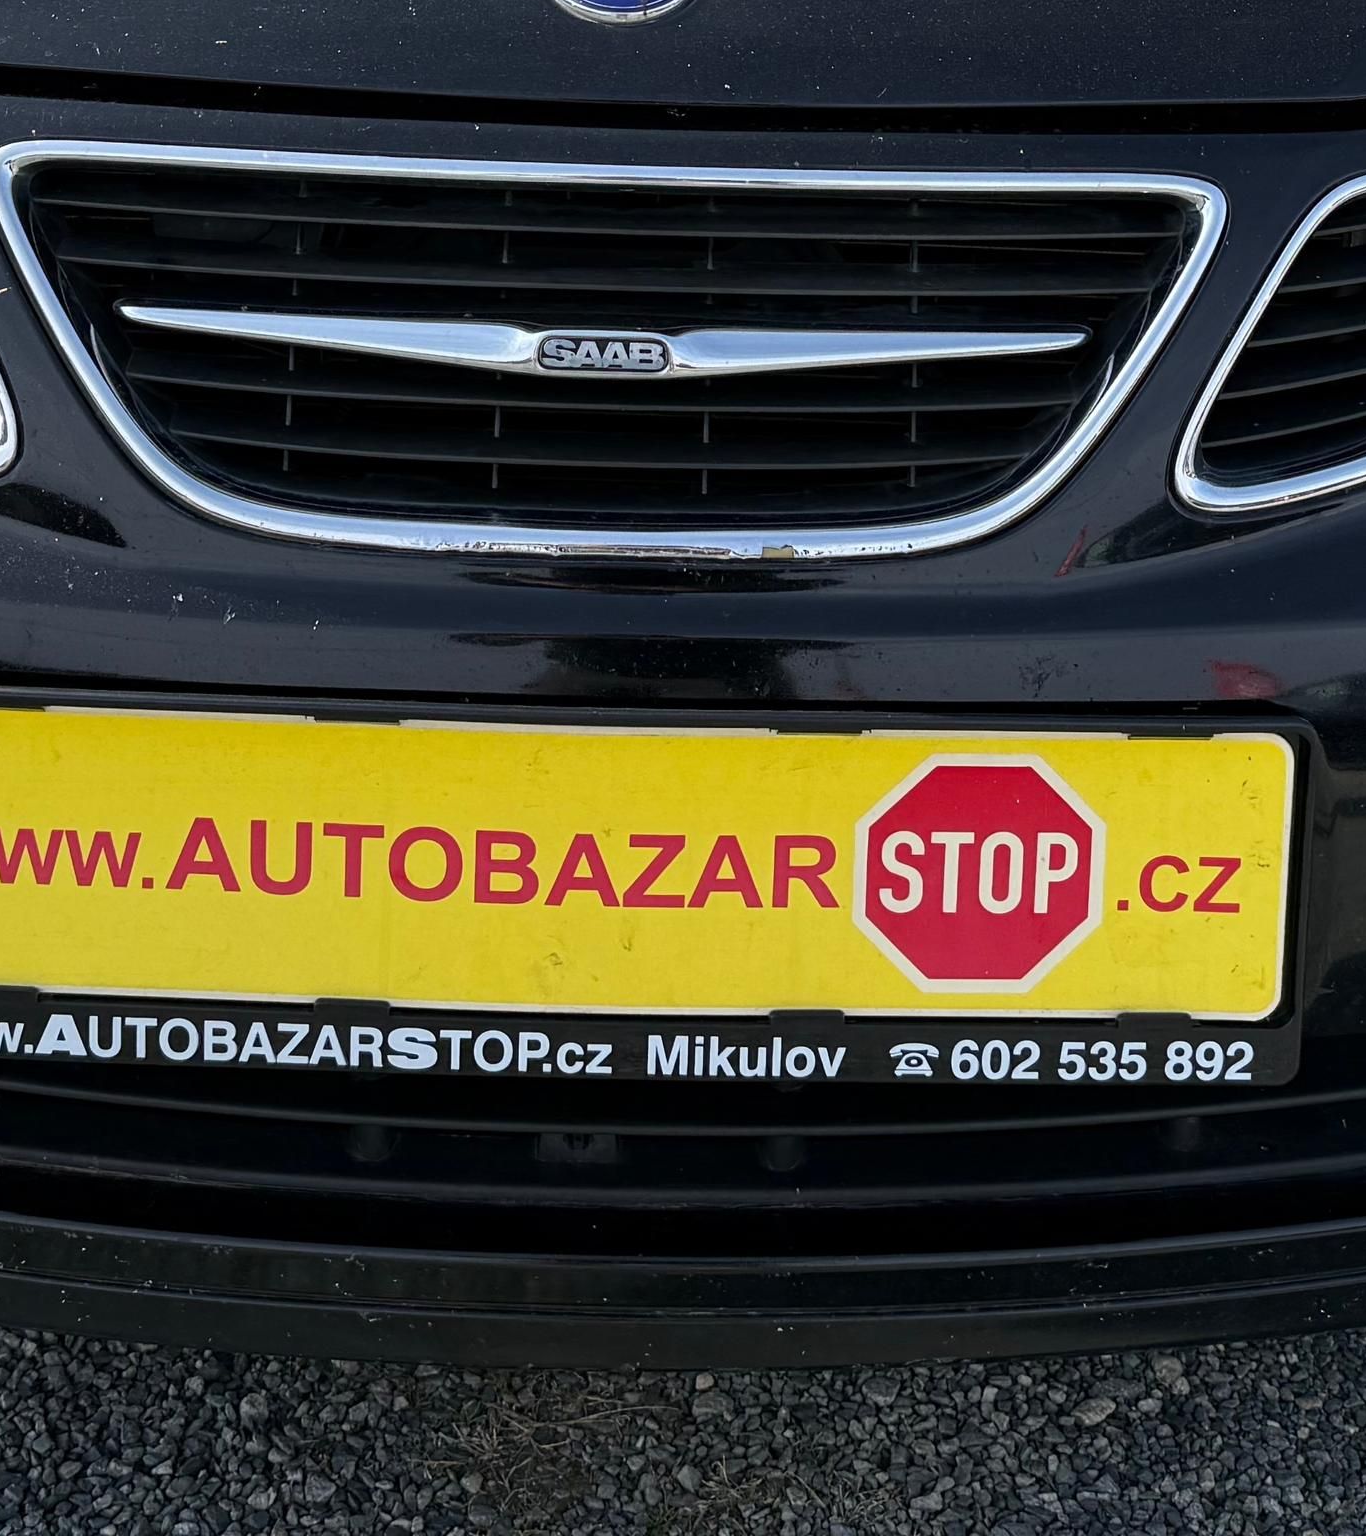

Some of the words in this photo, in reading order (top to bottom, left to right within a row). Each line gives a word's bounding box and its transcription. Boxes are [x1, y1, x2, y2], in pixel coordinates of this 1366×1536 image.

[541, 338, 666, 371] SAAB
[646, 1034, 847, 1078] Mikulov
[950, 1039, 1041, 1081] 602
[1057, 1041, 1148, 1082] 535
[1163, 1040, 1255, 1082] 892
